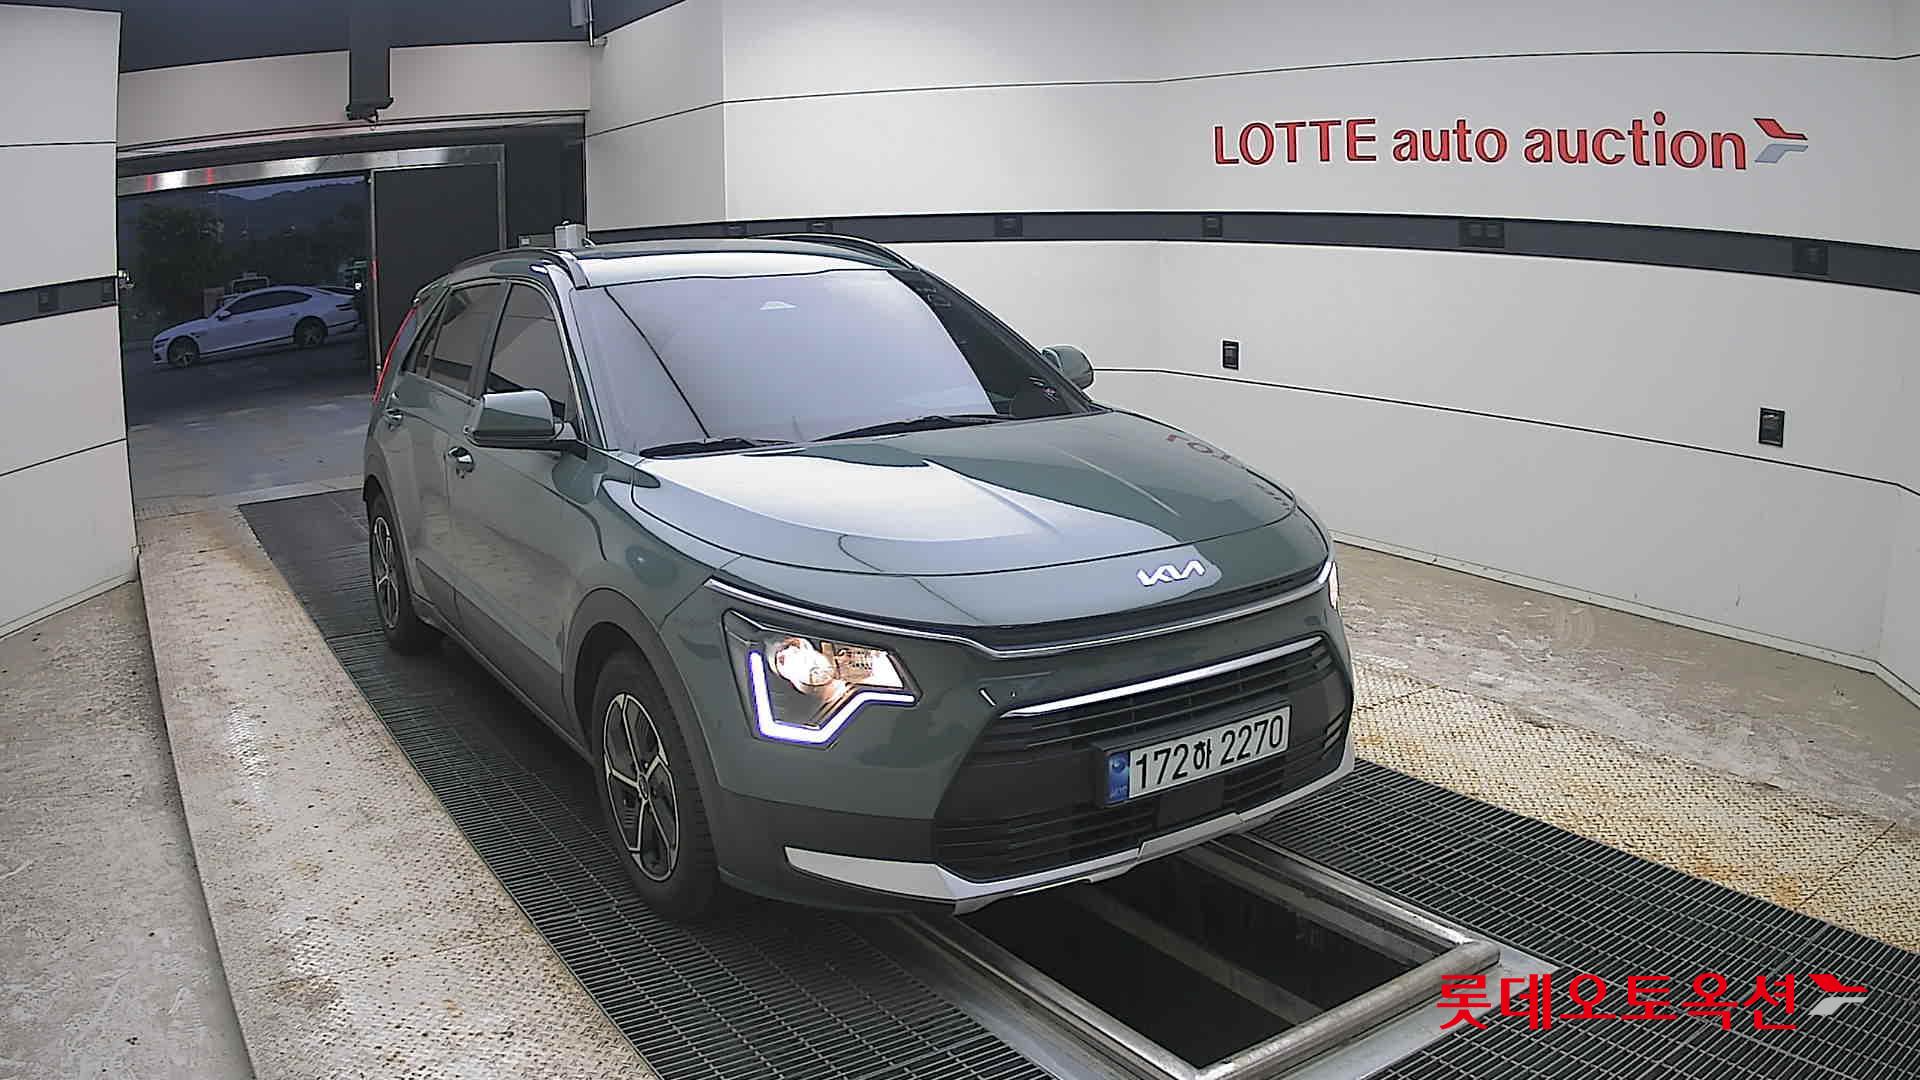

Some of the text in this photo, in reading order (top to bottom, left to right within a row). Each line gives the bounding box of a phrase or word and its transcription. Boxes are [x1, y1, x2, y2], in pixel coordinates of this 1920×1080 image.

[1213, 111, 1747, 171] LOTTE auto auction
[1135, 715, 1284, 790] 172하 2270
